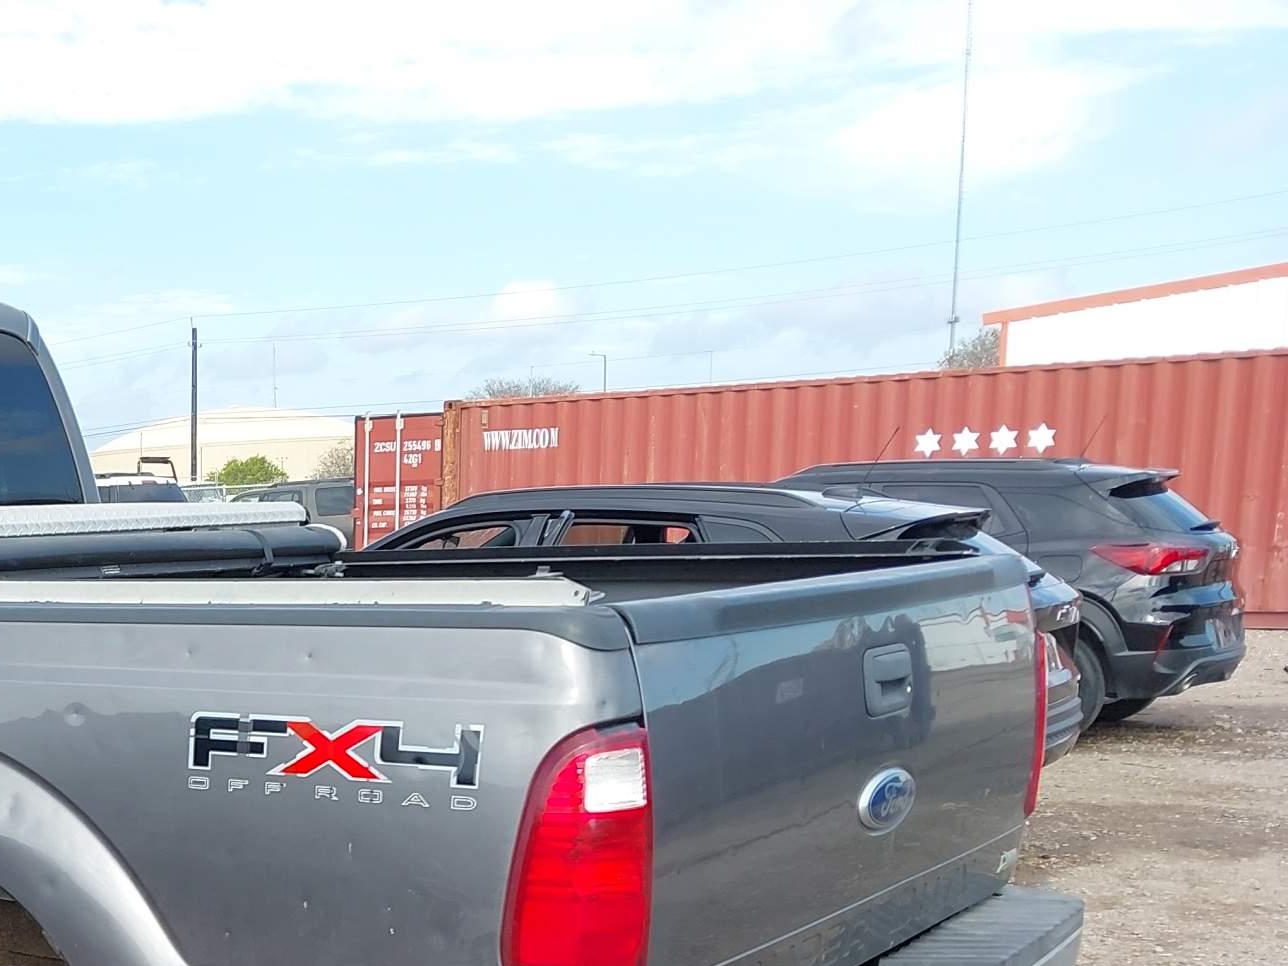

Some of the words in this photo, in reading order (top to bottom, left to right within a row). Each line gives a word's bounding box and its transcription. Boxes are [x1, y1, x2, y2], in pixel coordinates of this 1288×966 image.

[403, 453, 422, 465] 42G1
[188, 711, 484, 790] FX4
[188, 776, 287, 796] OFF
[314, 784, 477, 812] ROAD
